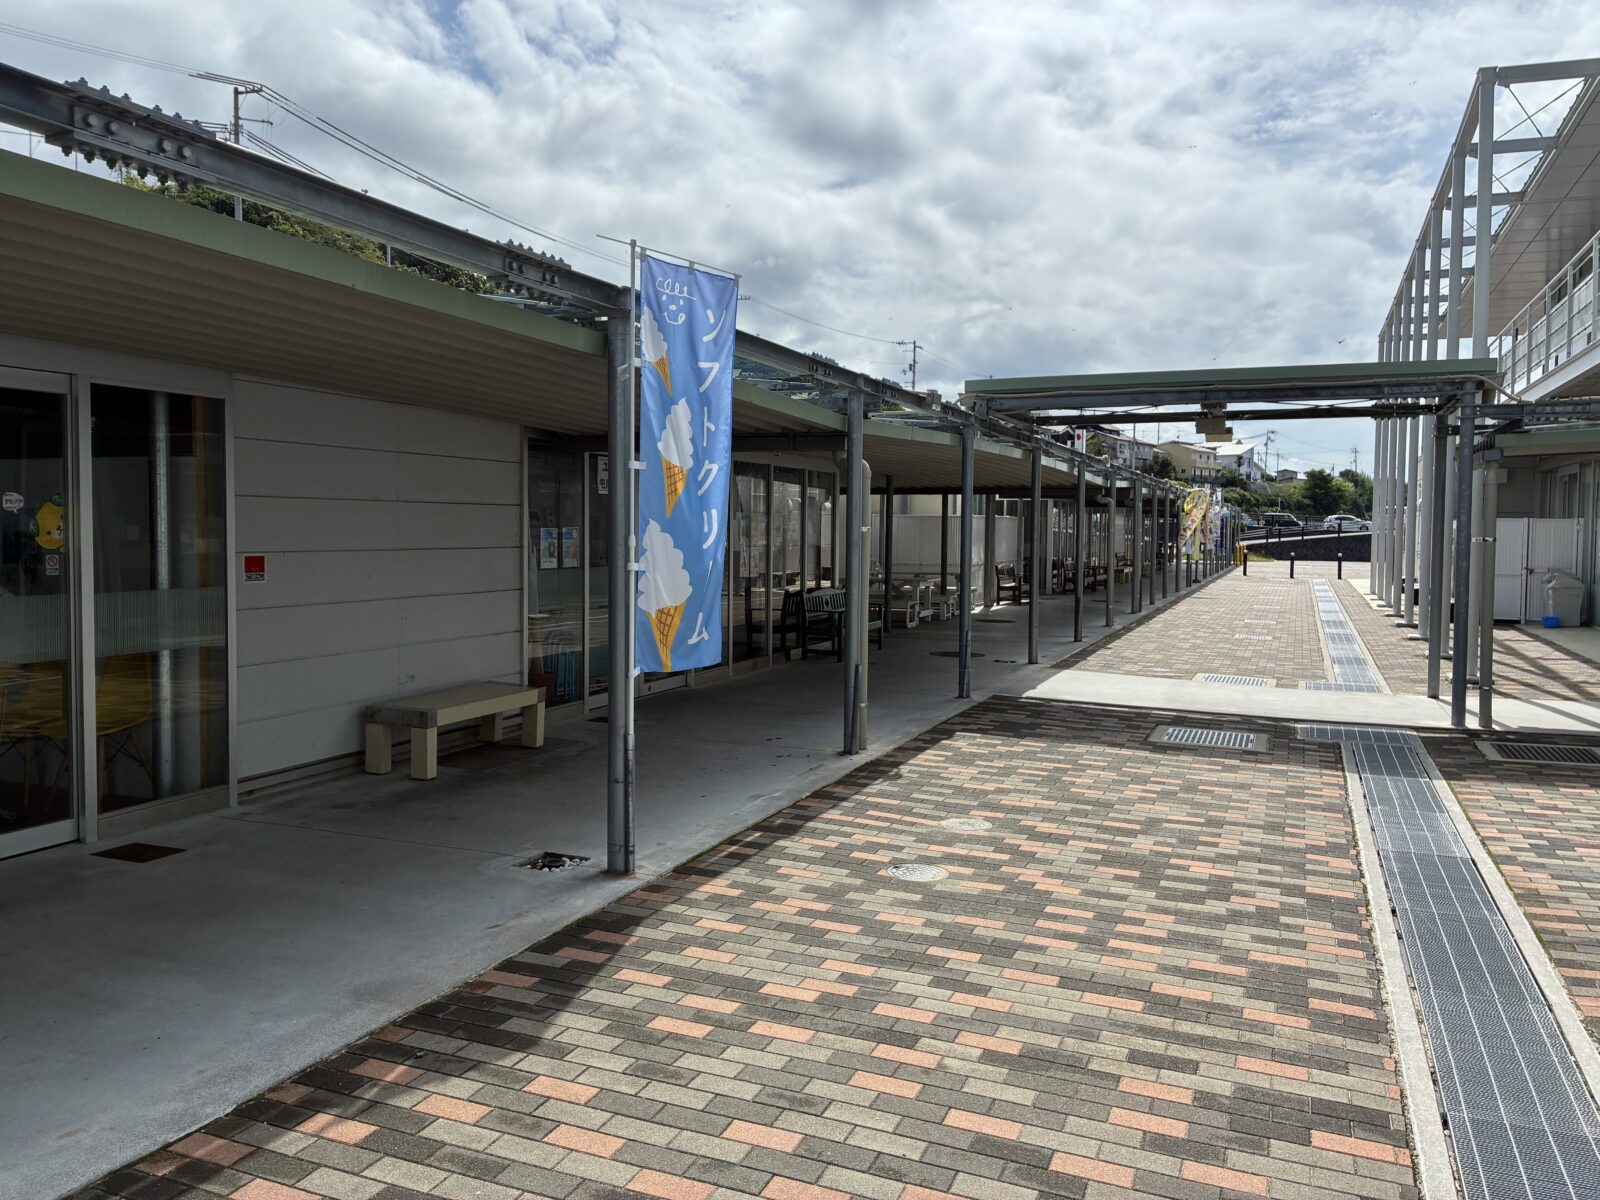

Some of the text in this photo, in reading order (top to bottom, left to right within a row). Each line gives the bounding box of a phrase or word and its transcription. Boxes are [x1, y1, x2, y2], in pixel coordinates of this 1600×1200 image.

[688, 308, 727, 645] ソフトクリーム
